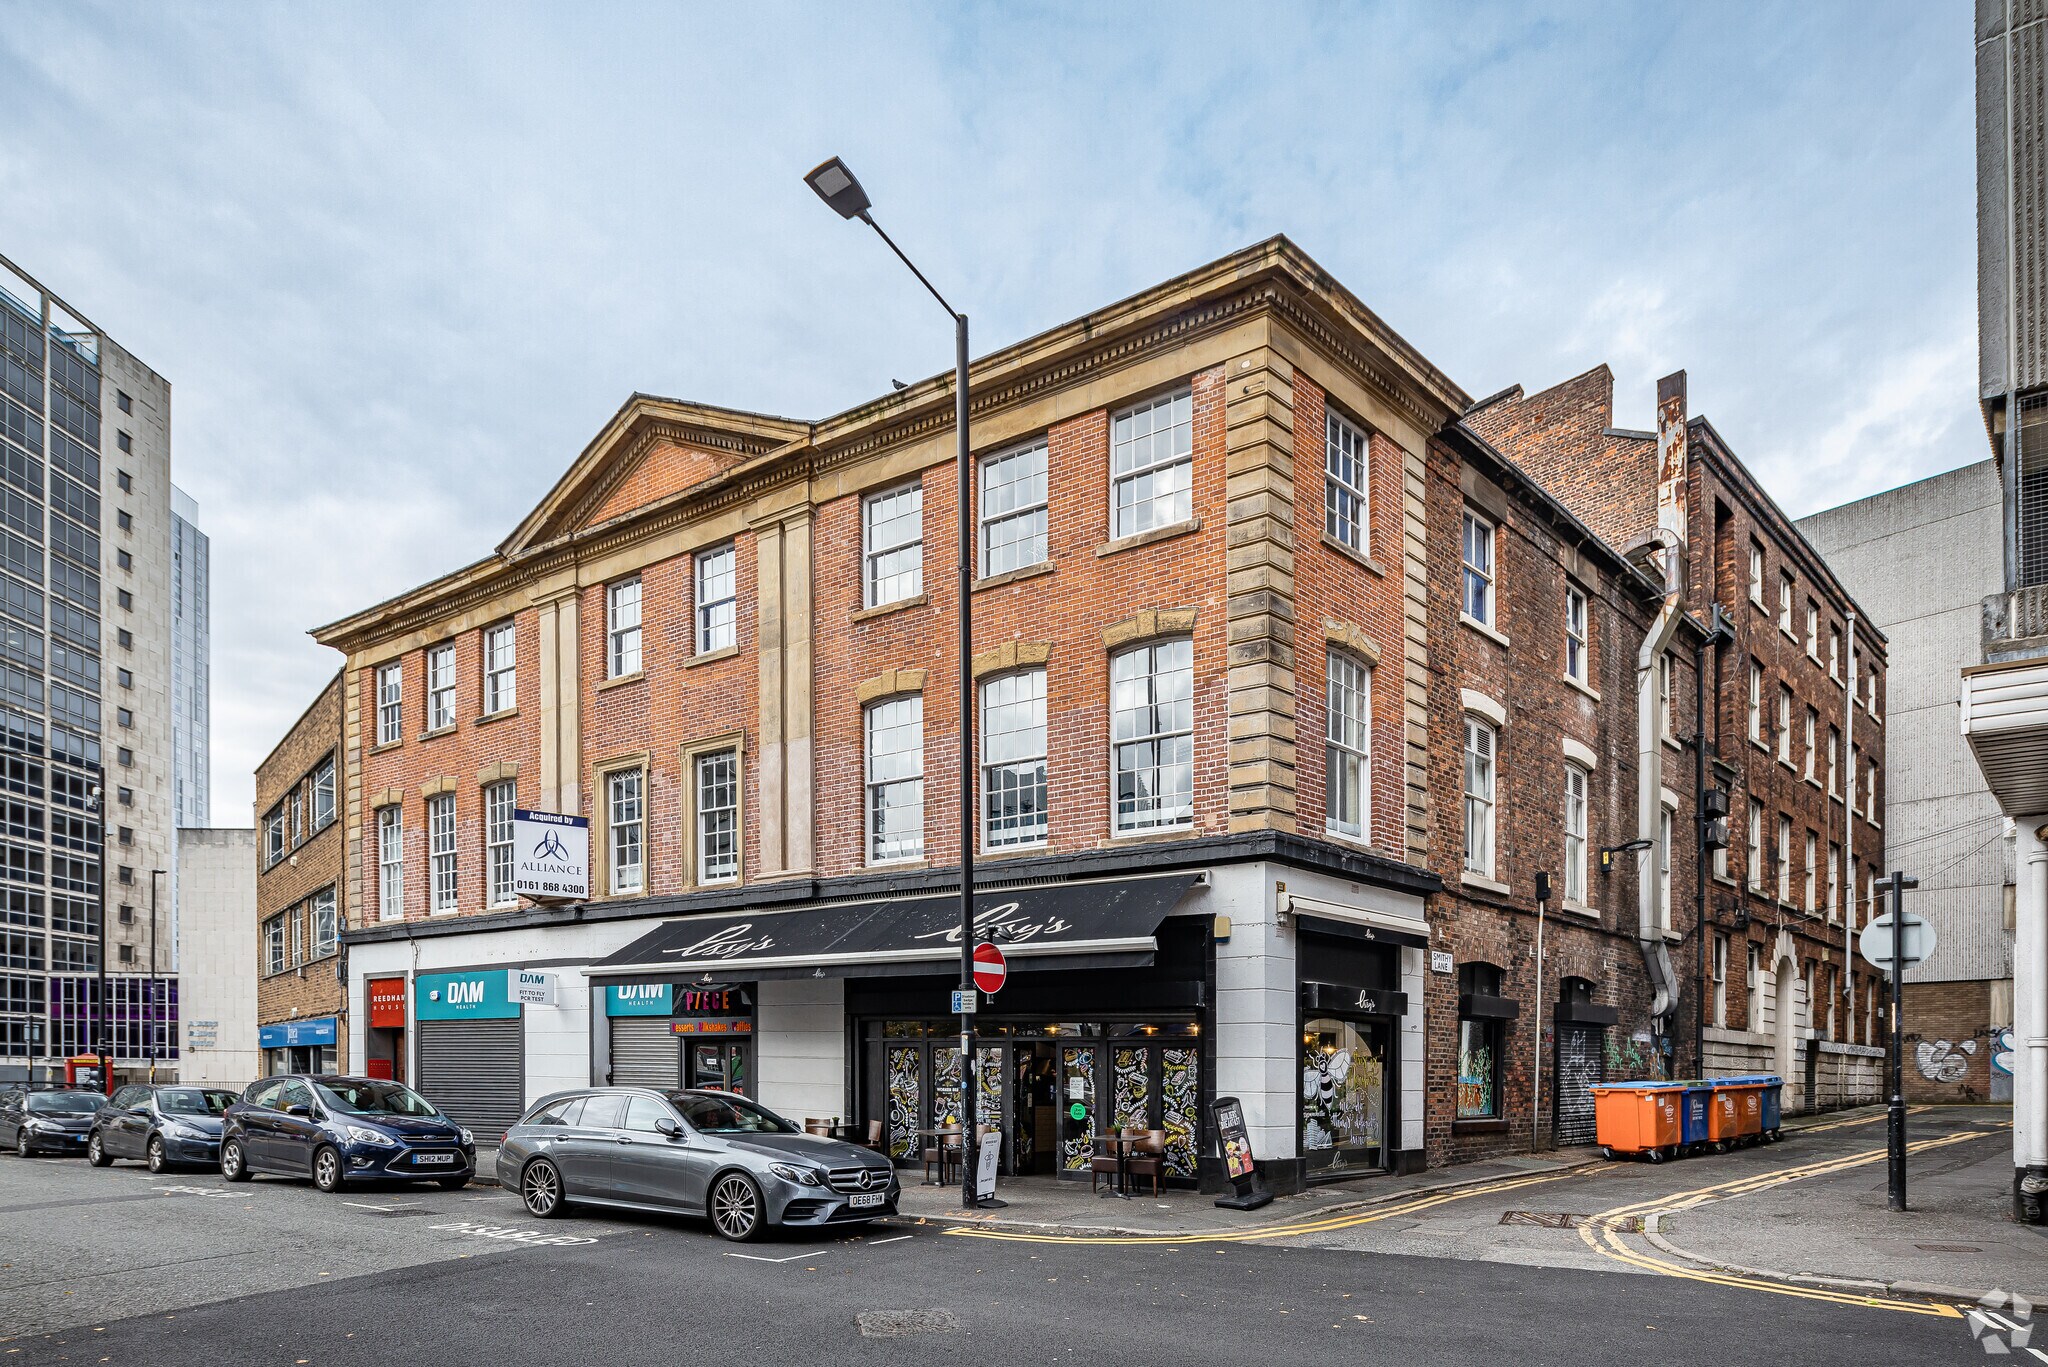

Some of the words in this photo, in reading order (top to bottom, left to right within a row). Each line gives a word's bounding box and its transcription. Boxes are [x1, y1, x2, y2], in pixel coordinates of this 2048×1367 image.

[529, 811, 563, 823] Acquired
[564, 815, 574, 825] by
[520, 861, 582, 876] ALLIANCE
[517, 880, 539, 890] 0161
[542, 882, 560, 892] 868
[562, 883, 585, 894] 4300
[1433, 952, 1452, 962] SMITHY
[1434, 961, 1448, 971] LANE
[520, 973, 545, 985] DAM
[447, 980, 485, 1004] DAM
[374, 1003, 406, 1011] HOUSE
[672, 1022, 695, 1033] Desserts
[698, 1020, 727, 1033] Milkshakes
[731, 1020, 752, 1033] Waffles
[419, 1155, 436, 1163] SH12
[437, 1155, 451, 1163] MUP
[852, 1195, 871, 1206] OE68
[427, 1222, 599, 1246] DISABLED
